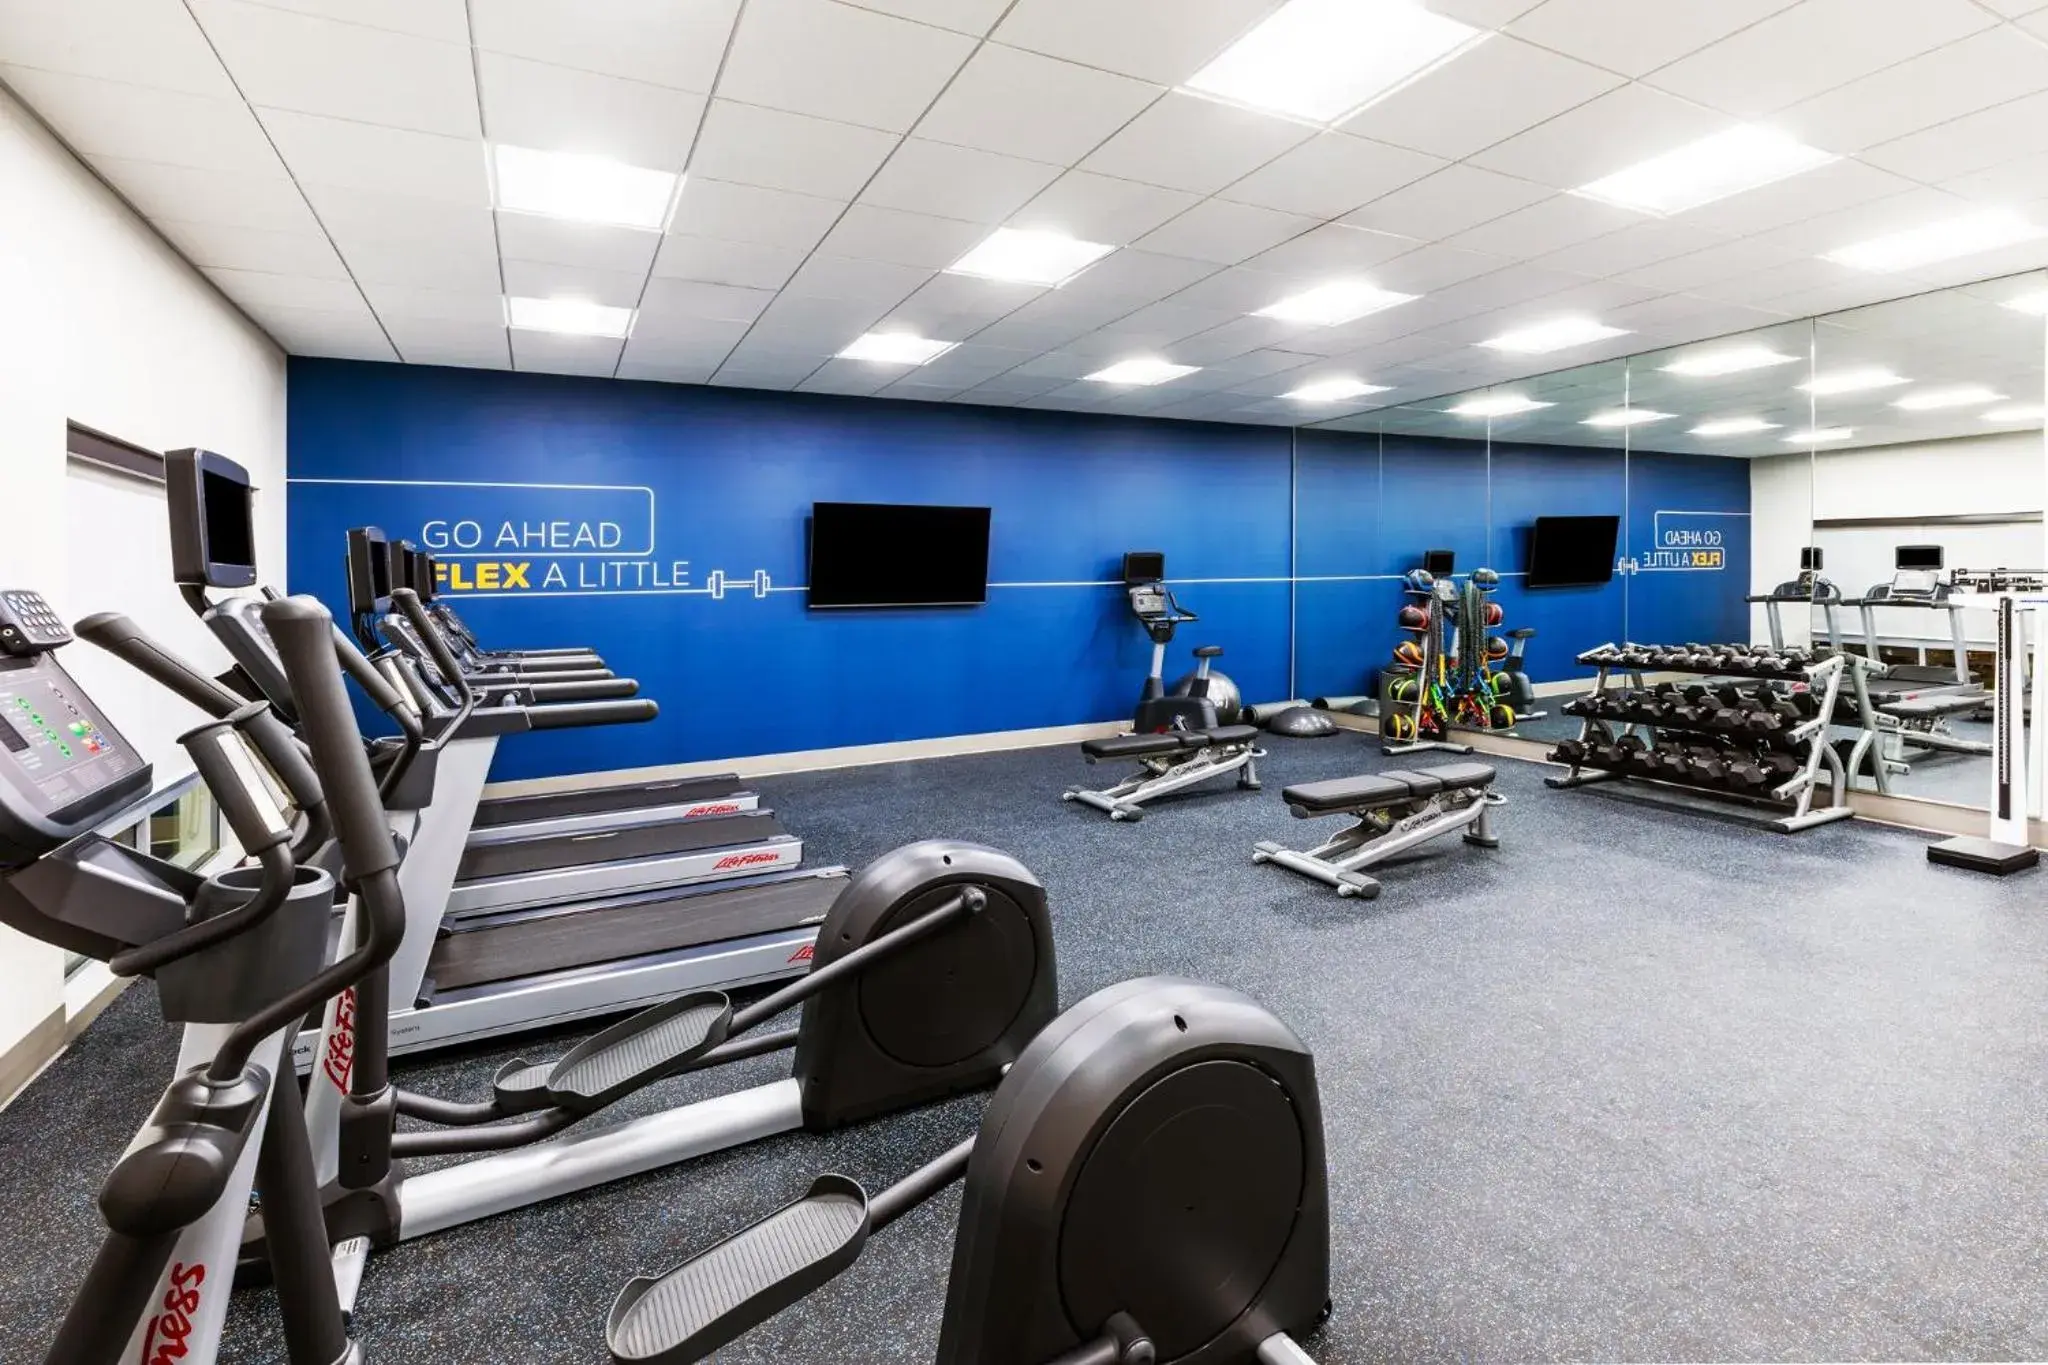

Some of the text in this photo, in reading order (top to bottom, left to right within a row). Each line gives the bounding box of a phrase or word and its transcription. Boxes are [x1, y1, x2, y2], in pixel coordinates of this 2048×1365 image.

[422, 520, 622, 549] GO AHEAD
[542, 562, 567, 588] A
[580, 561, 690, 587] LITTLE
[323, 1031, 354, 1096] Life
[141, 1262, 205, 1365] ness
